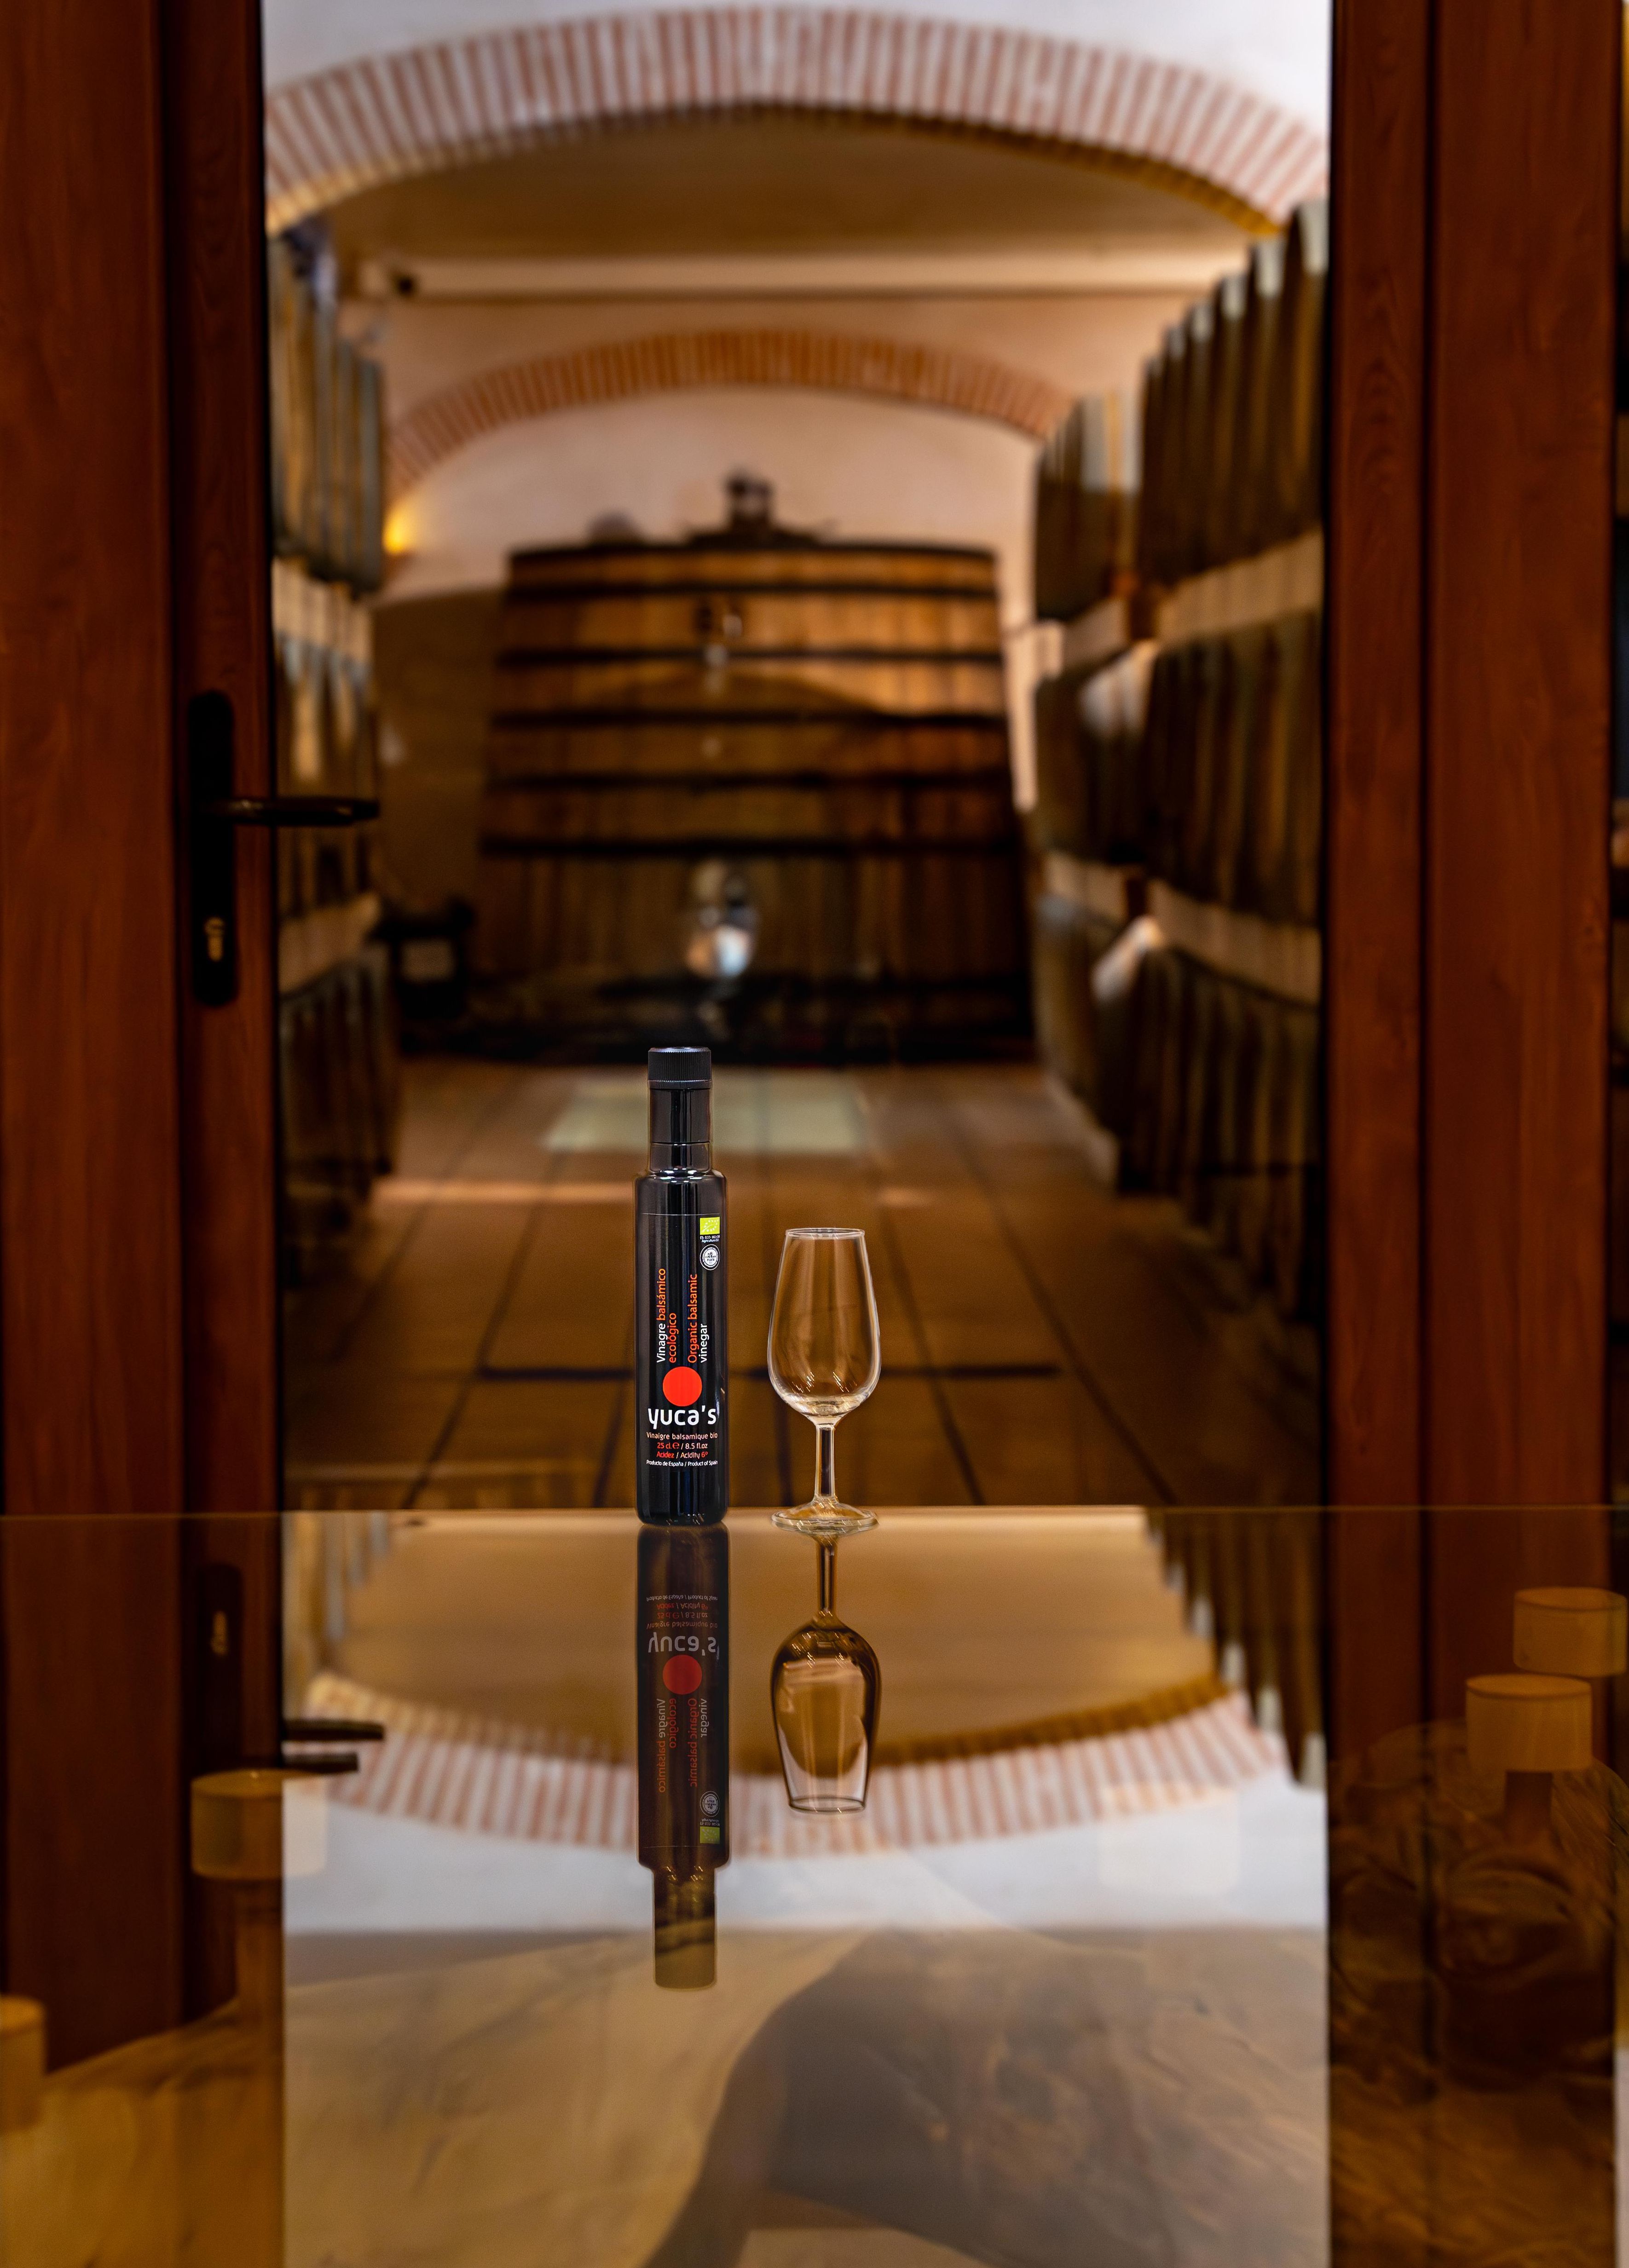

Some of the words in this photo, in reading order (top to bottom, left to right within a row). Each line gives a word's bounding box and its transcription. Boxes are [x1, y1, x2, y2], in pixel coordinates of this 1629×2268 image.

[656, 1268, 666, 1321] balsámico
[687, 1274, 698, 1320] balsamic
[657, 1323, 667, 1363] Vinagre
[667, 1312, 679, 1363] ecológico
[687, 1322, 699, 1363] Organic
[699, 1324, 709, 1363] vinegar
[646, 1432, 670, 1440] Vinaigre
[647, 1405, 716, 1429] yuca's
